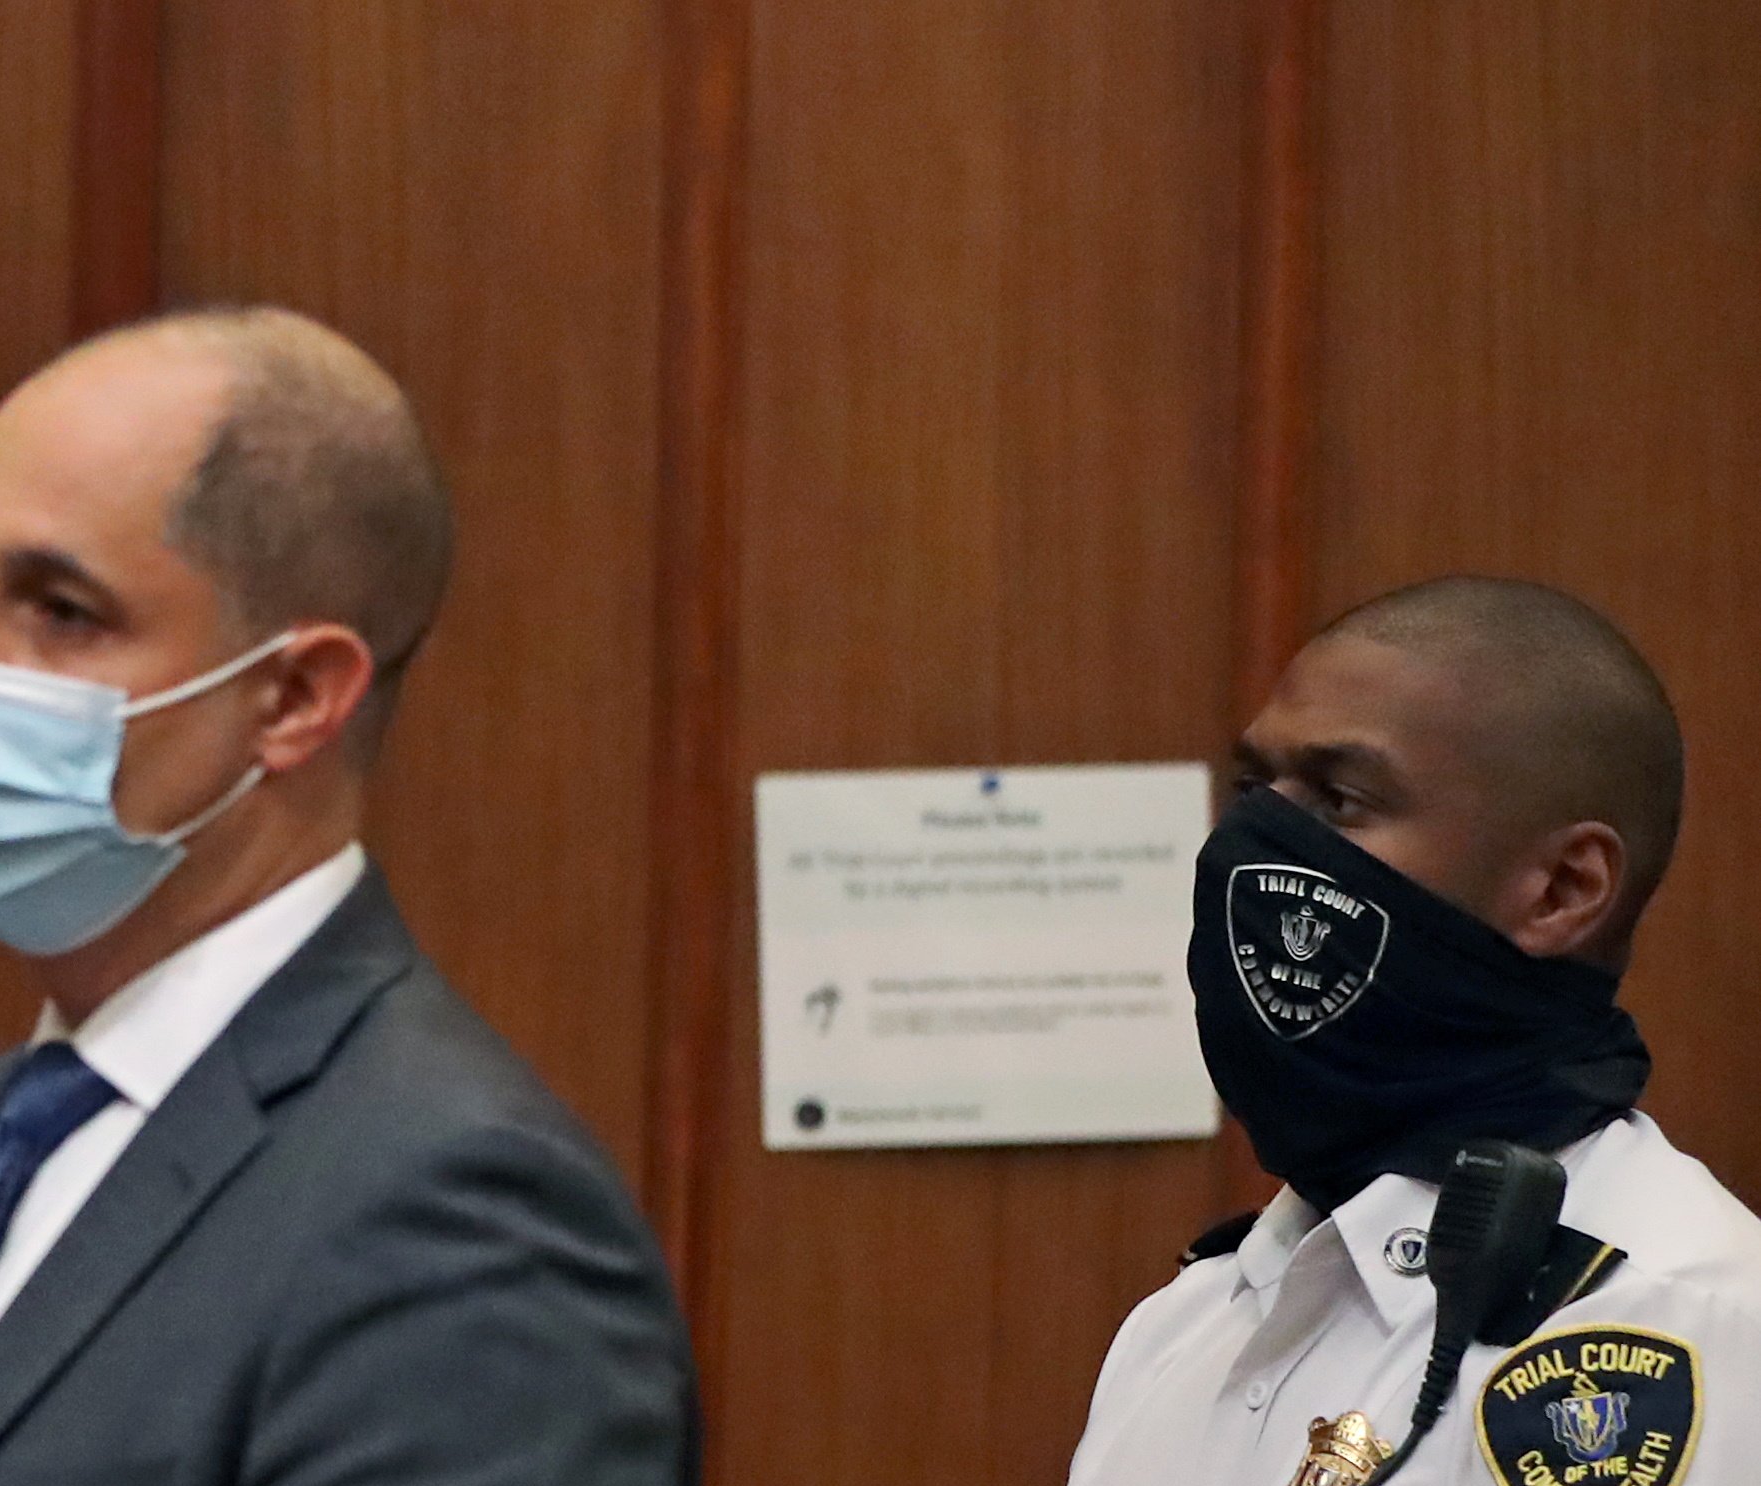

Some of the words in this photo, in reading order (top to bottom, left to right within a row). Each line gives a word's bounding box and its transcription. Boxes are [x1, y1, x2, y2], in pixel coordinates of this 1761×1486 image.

[1257, 874, 1306, 897] TRIAL
[1312, 884, 1366, 919] COURT
[1271, 963, 1291, 982] OF
[1493, 1349, 1575, 1401] TRIAL
[1580, 1343, 1675, 1380] COURT
[1564, 1464, 1588, 1483] OF
[1593, 1456, 1628, 1477] THE
